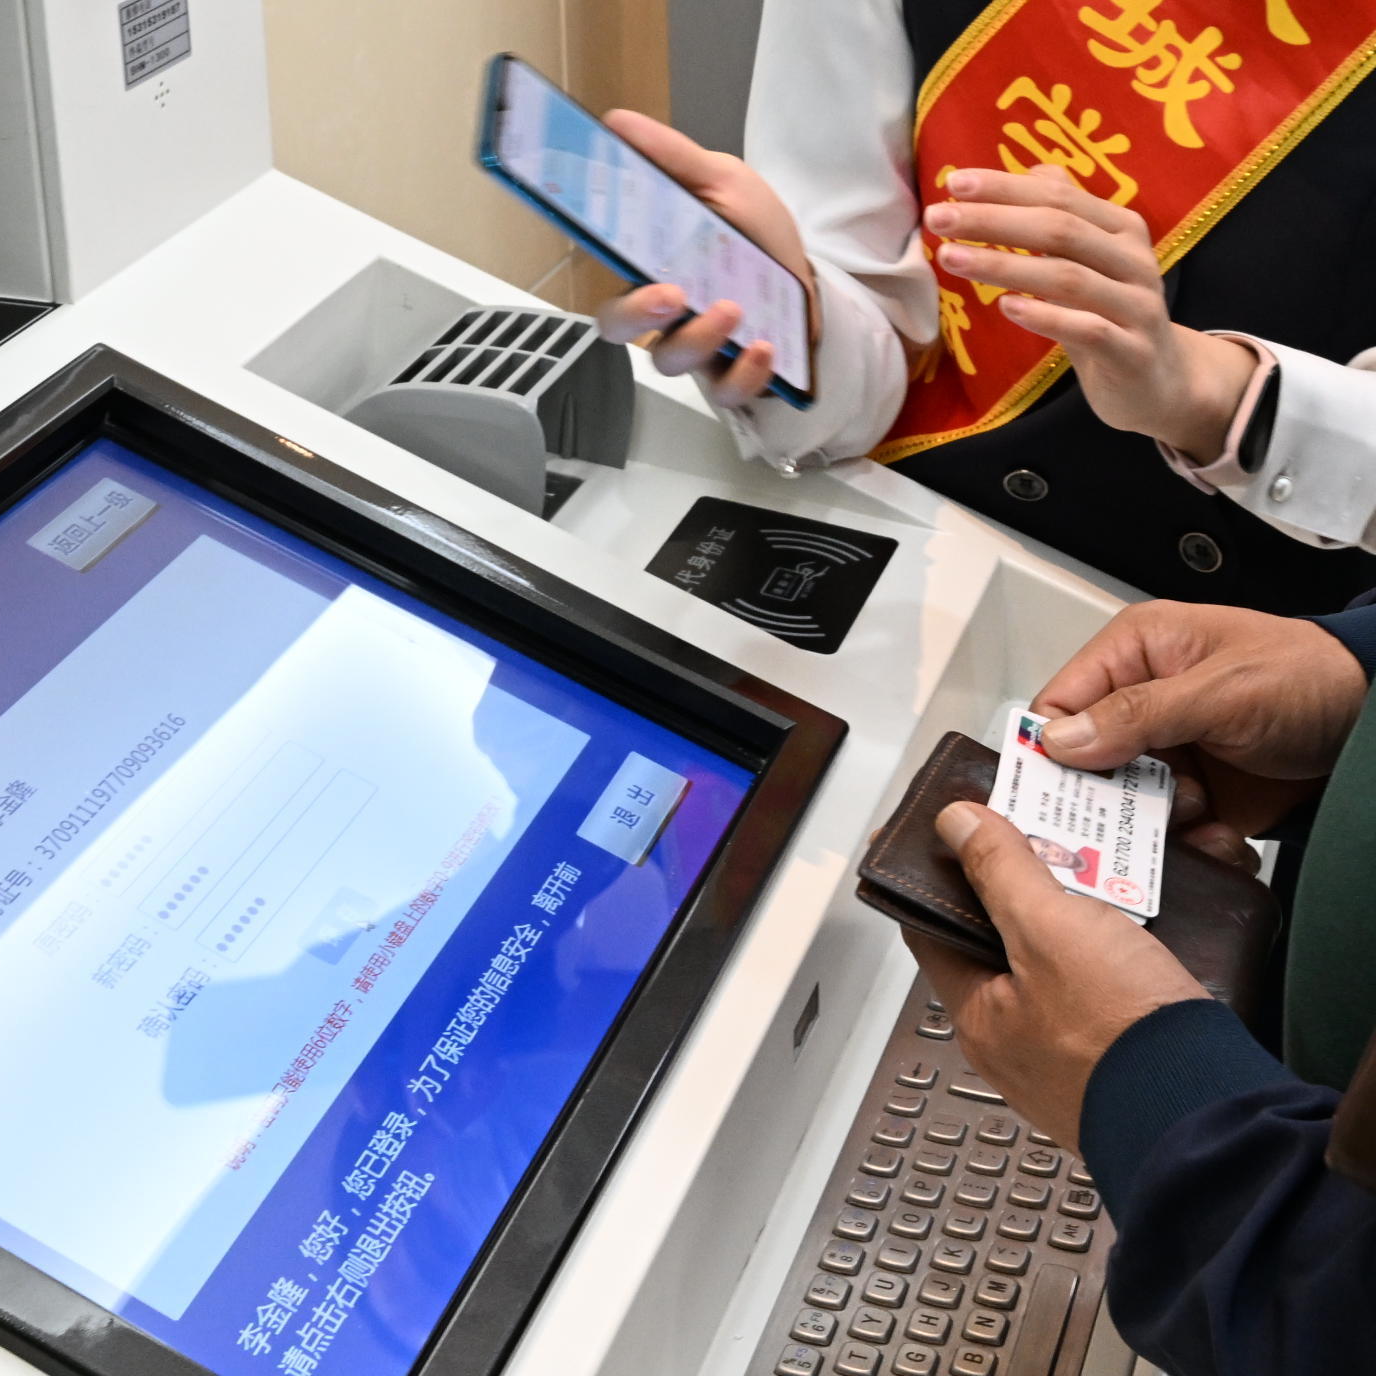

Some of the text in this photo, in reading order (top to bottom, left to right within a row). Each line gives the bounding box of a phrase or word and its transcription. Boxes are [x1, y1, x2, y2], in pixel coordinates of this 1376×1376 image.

[48, 491, 133, 555] 返回上一级
[943, 1246, 963, 1258] K
[875, 1279, 895, 1290] U
[987, 1280, 1008, 1293] M
[861, 1313, 882, 1326] Y
[919, 1314, 939, 1327] H
[974, 1315, 995, 1328] N
[848, 1350, 868, 1361] T
[906, 1351, 926, 1363] G
[963, 1352, 983, 1364] B
